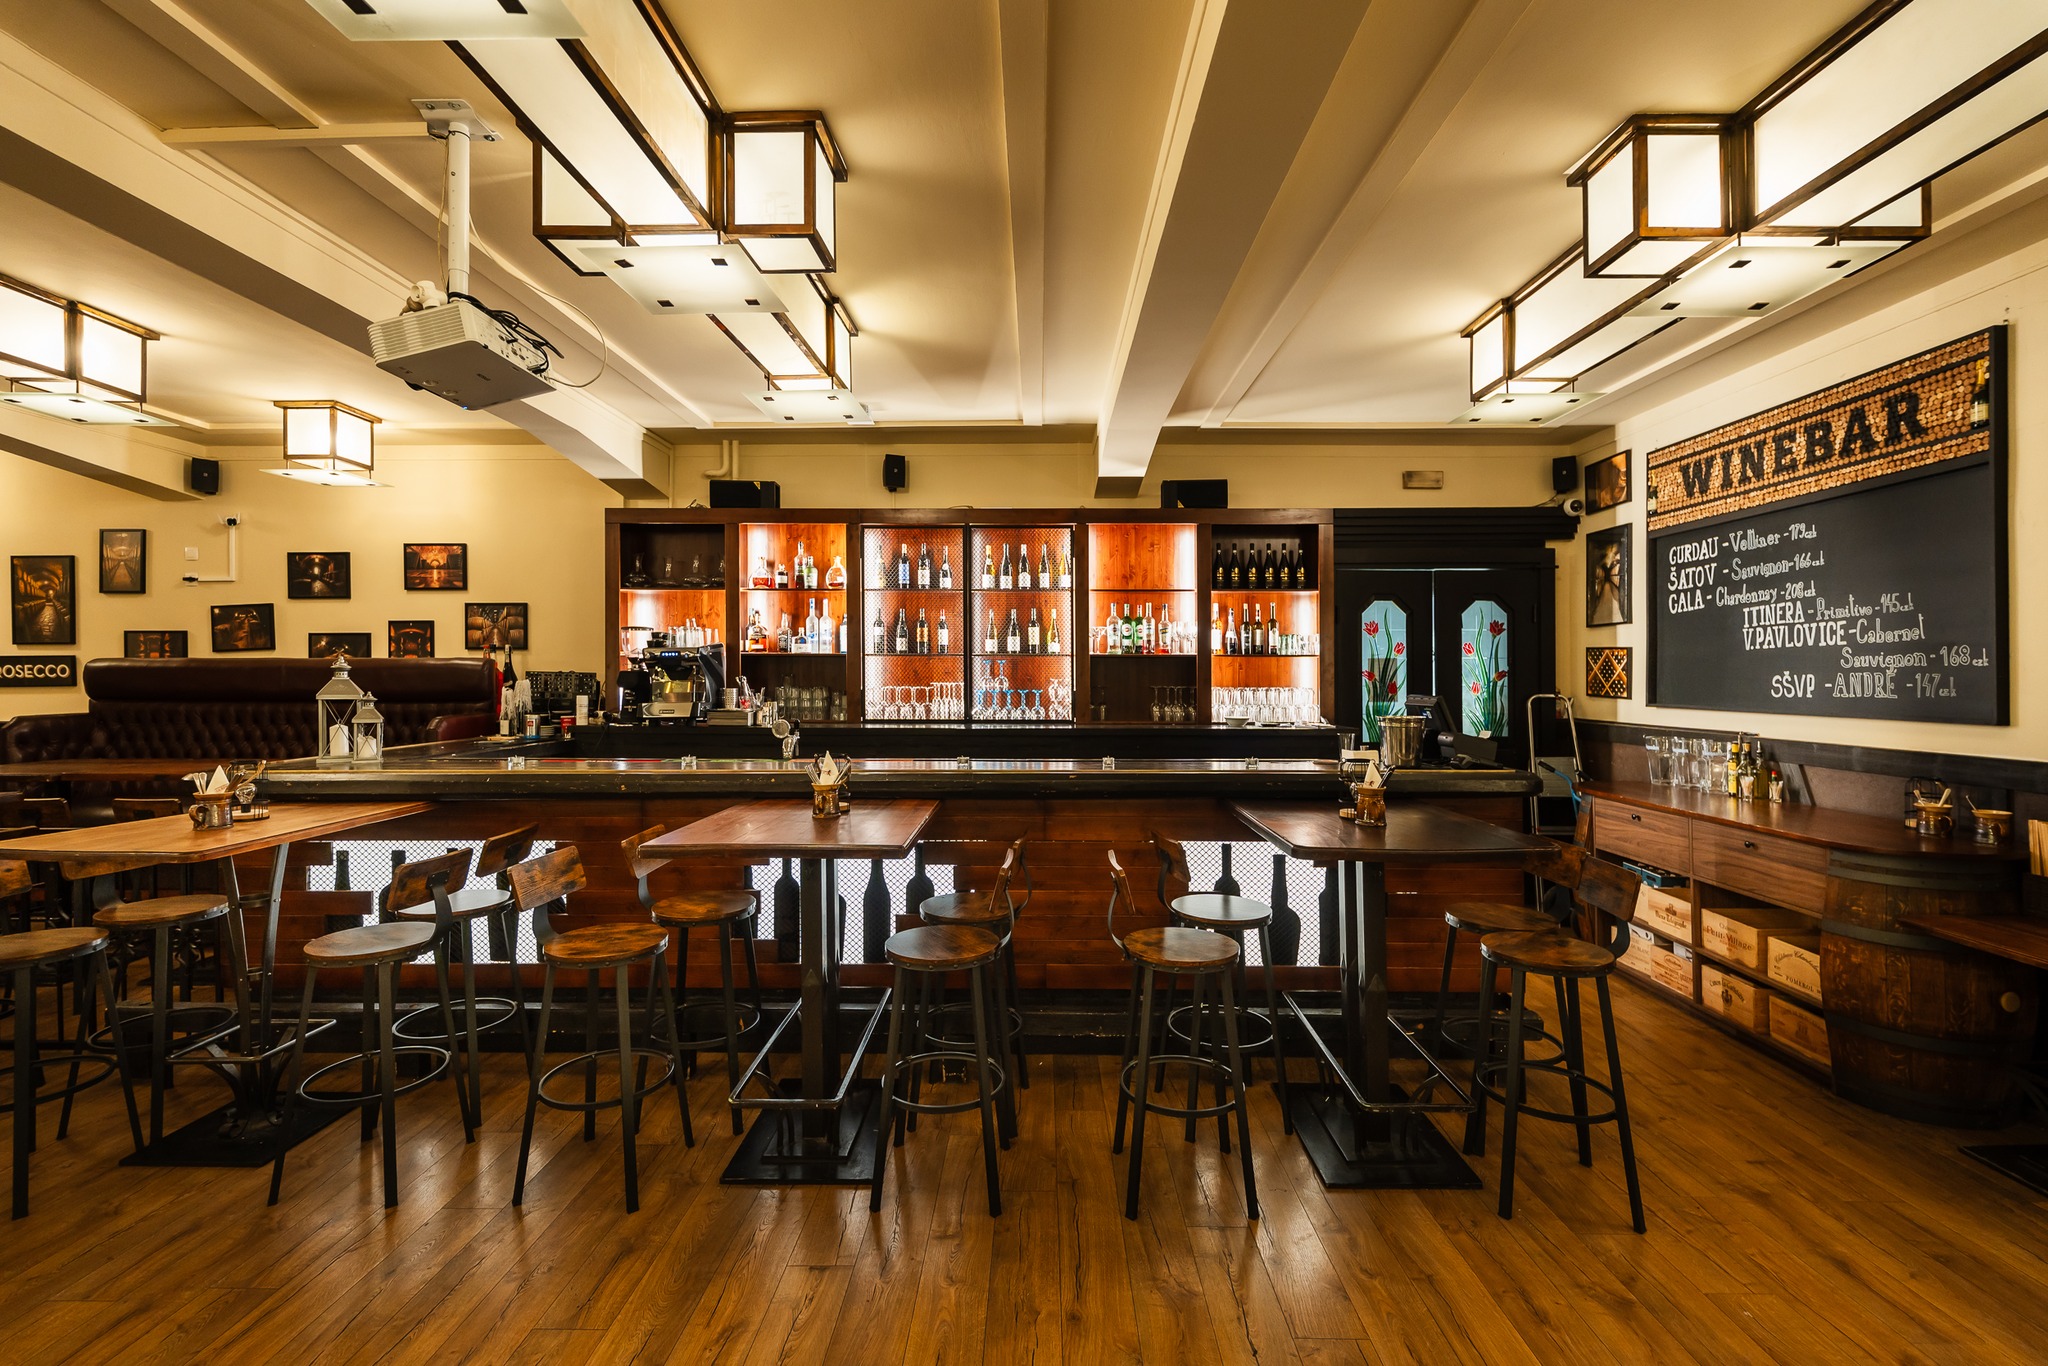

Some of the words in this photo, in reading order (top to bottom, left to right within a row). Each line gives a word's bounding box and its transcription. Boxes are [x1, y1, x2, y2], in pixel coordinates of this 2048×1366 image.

[1679, 391, 1929, 498] WINEBAR
[1669, 537, 1719, 565] GURDAU
[1667, 563, 1717, 591] ŠATOV
[1668, 589, 1705, 614] GALA
[1716, 583, 1777, 607] Chardonnay
[1743, 600, 1805, 628] ITINERA
[1816, 594, 1873, 621] Primitivo
[0, 664, 70, 678] OSECCO
[1840, 646, 1927, 673] Sauvignon
[1770, 671, 1815, 698] SŠVP
